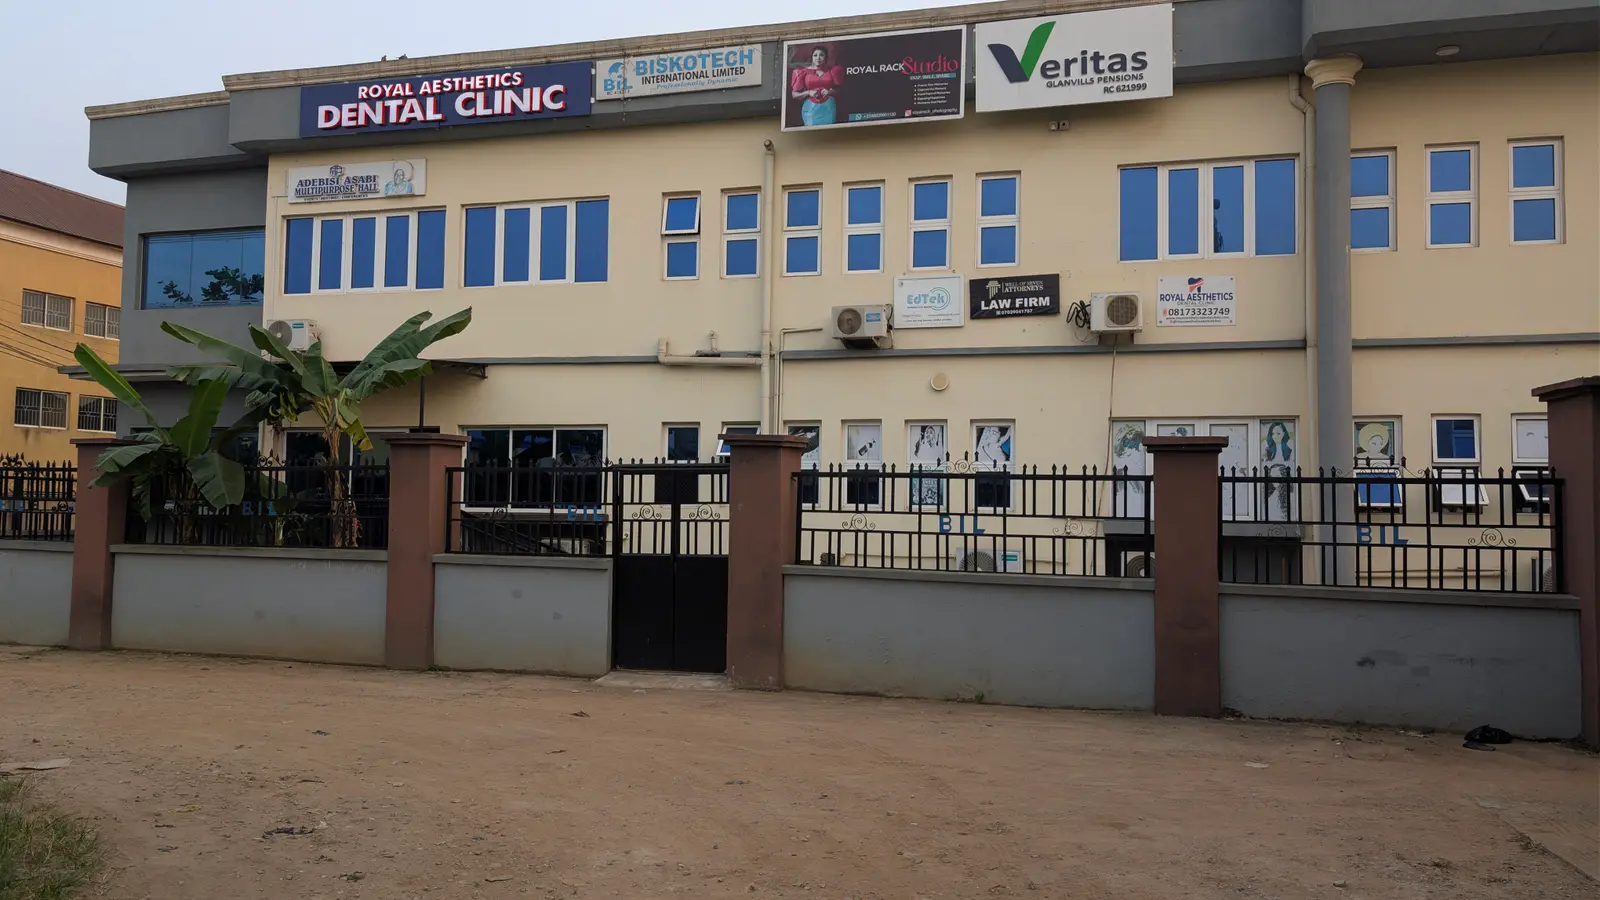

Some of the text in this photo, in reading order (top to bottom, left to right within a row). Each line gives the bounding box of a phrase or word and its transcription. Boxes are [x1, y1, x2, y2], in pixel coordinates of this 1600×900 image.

[987, 20, 1148, 83] Veritas
[635, 48, 753, 76] BISKOTECH
[846, 54, 959, 75] ROYAL RACK Studio
[642, 66, 745, 85] INTERNATIONAL LIMITED
[656, 77, 738, 89] Professionally Dynamic
[1046, 73, 1144, 88] GLANVILLS PENSIONS
[358, 71, 523, 100] ROYAL AESTHETICS
[1103, 83, 1147, 94] RC 621999
[318, 84, 567, 129] DENTAL CLINIC
[296, 174, 378, 188] ADEBISI ASABI
[295, 183, 379, 196] MULTIPURPOSE HALL
[907, 293, 945, 304] EdTek
[981, 296, 1050, 310] LAW FIRM
[1160, 292, 1233, 301] ROYAL AESTHETICS
[1168, 307, 1230, 316] 08173323749
[568, 505, 603, 521] BIL
[940, 515, 985, 534] BIL
[1357, 524, 1409, 545] BIL
